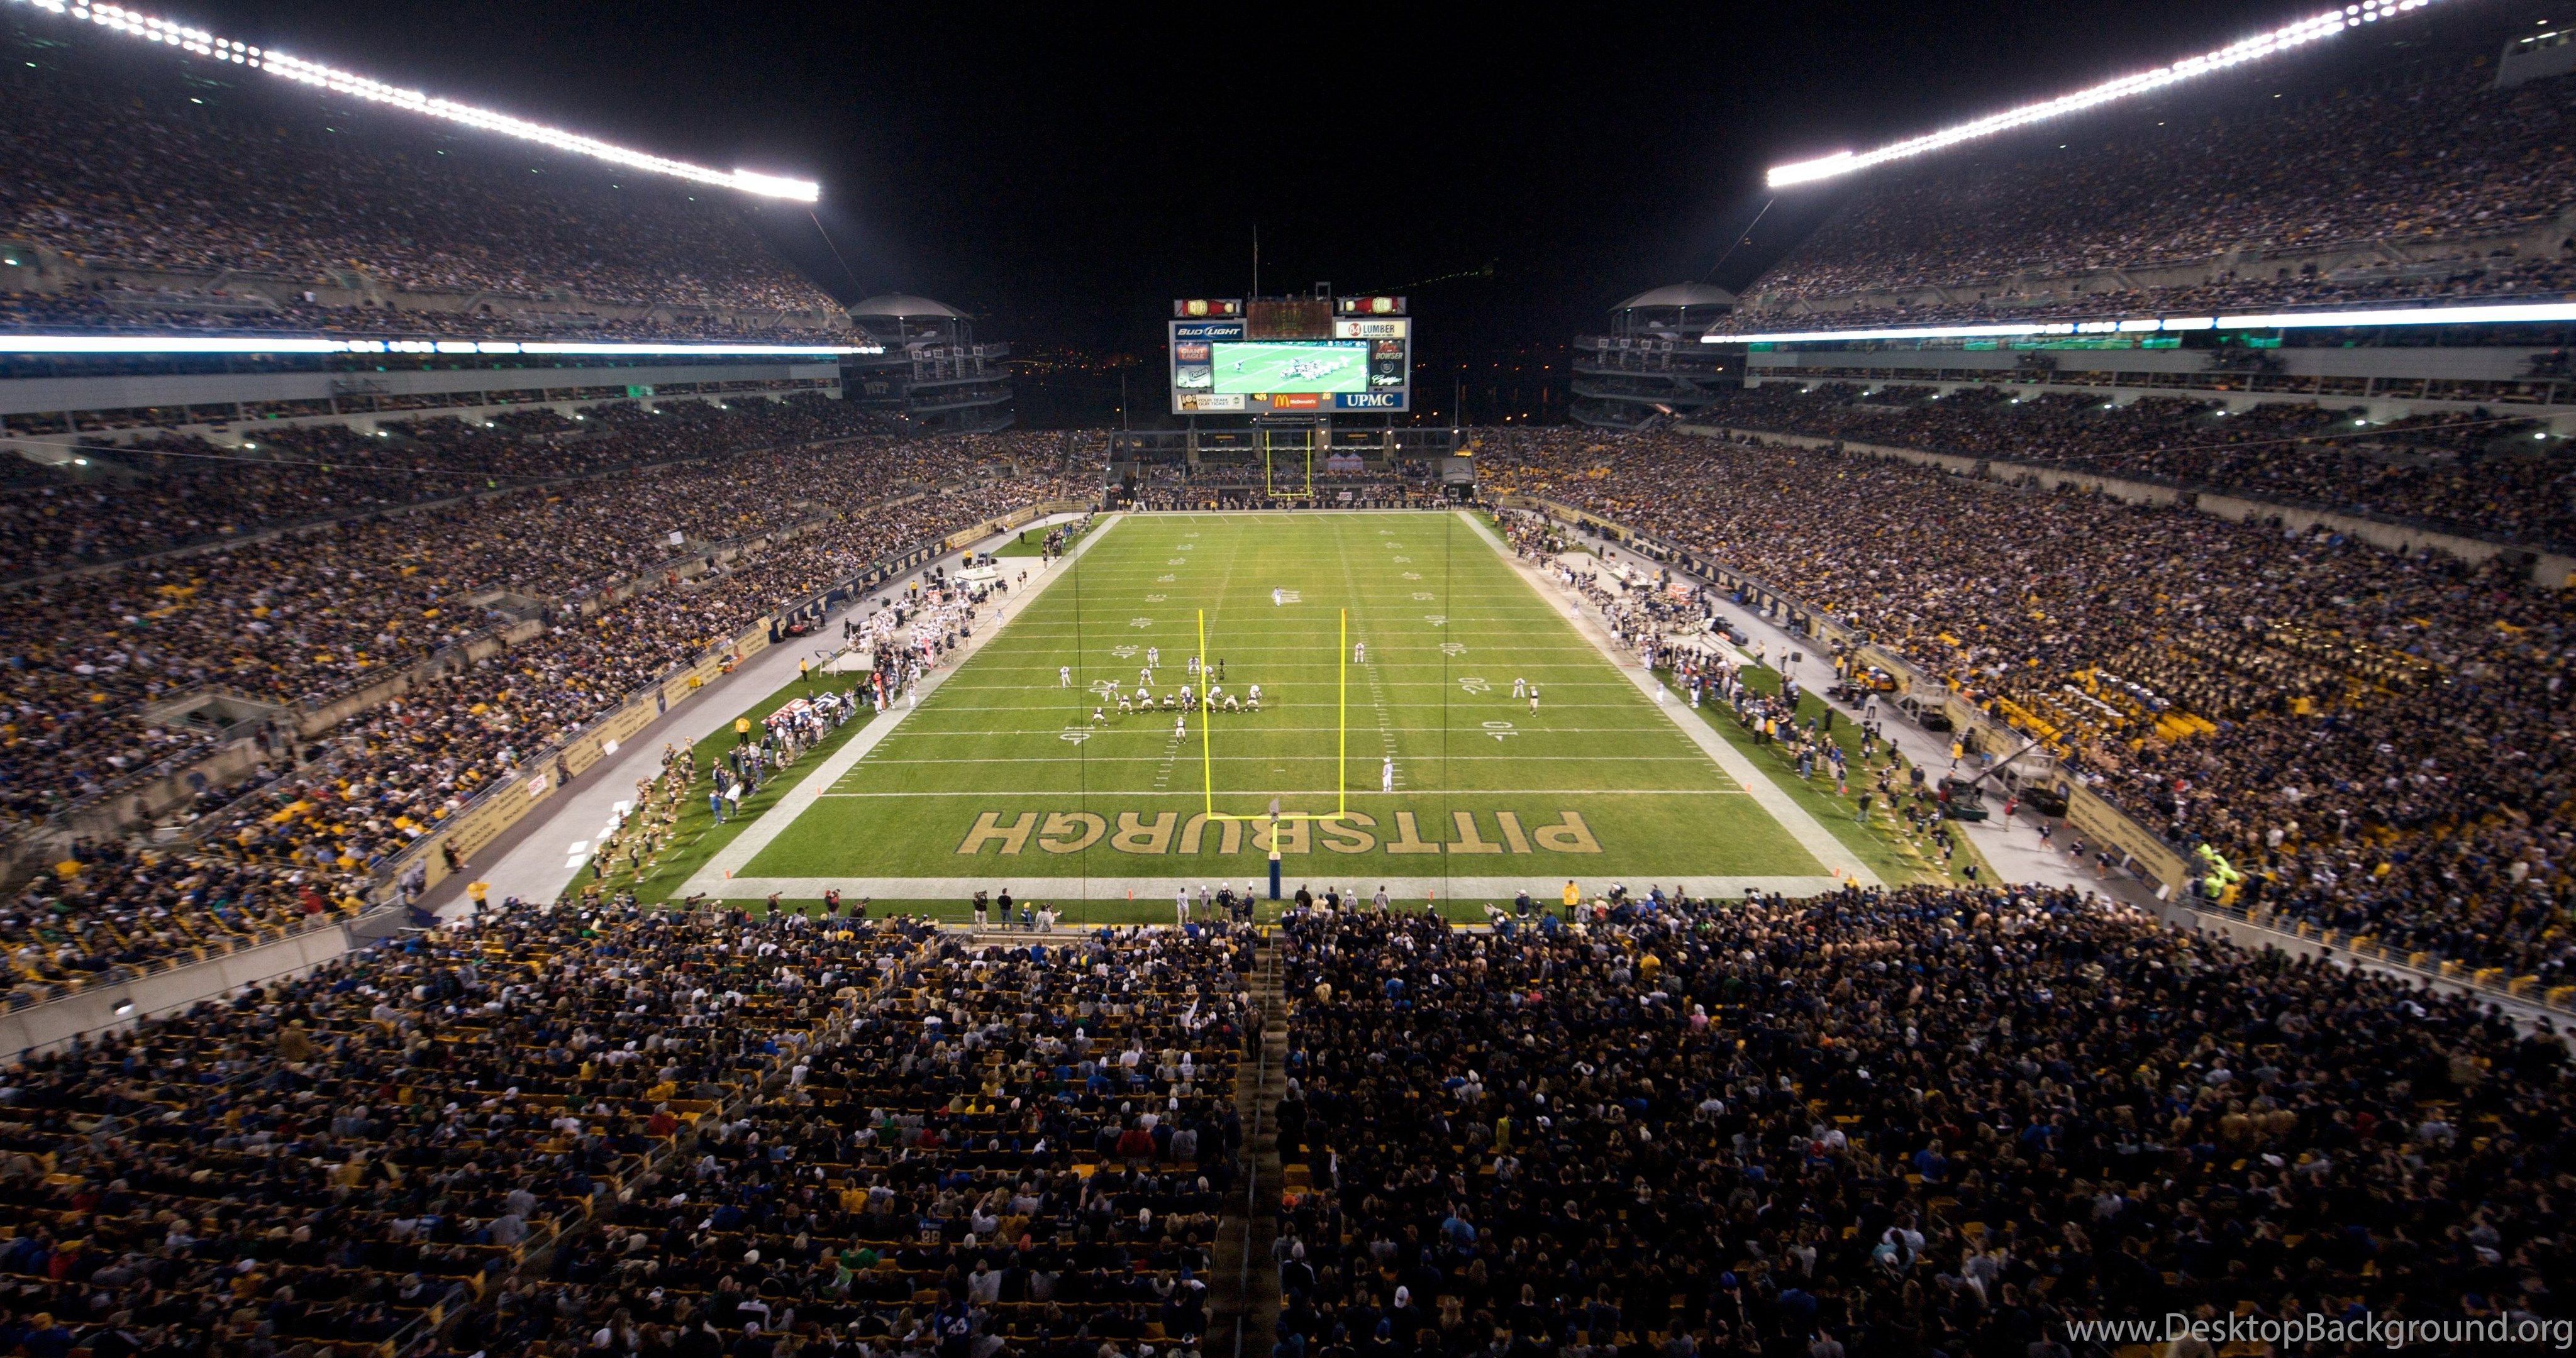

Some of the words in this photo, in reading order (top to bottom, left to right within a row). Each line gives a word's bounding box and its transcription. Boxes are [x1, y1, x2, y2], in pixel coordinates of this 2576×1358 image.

[1363, 325, 1394, 333] LUMBER
[1346, 394, 1394, 407] UPMC
[1458, 678, 1492, 692] 20
[1482, 721, 1519, 736] 10
[953, 810, 1606, 855] PITTSBURGH
